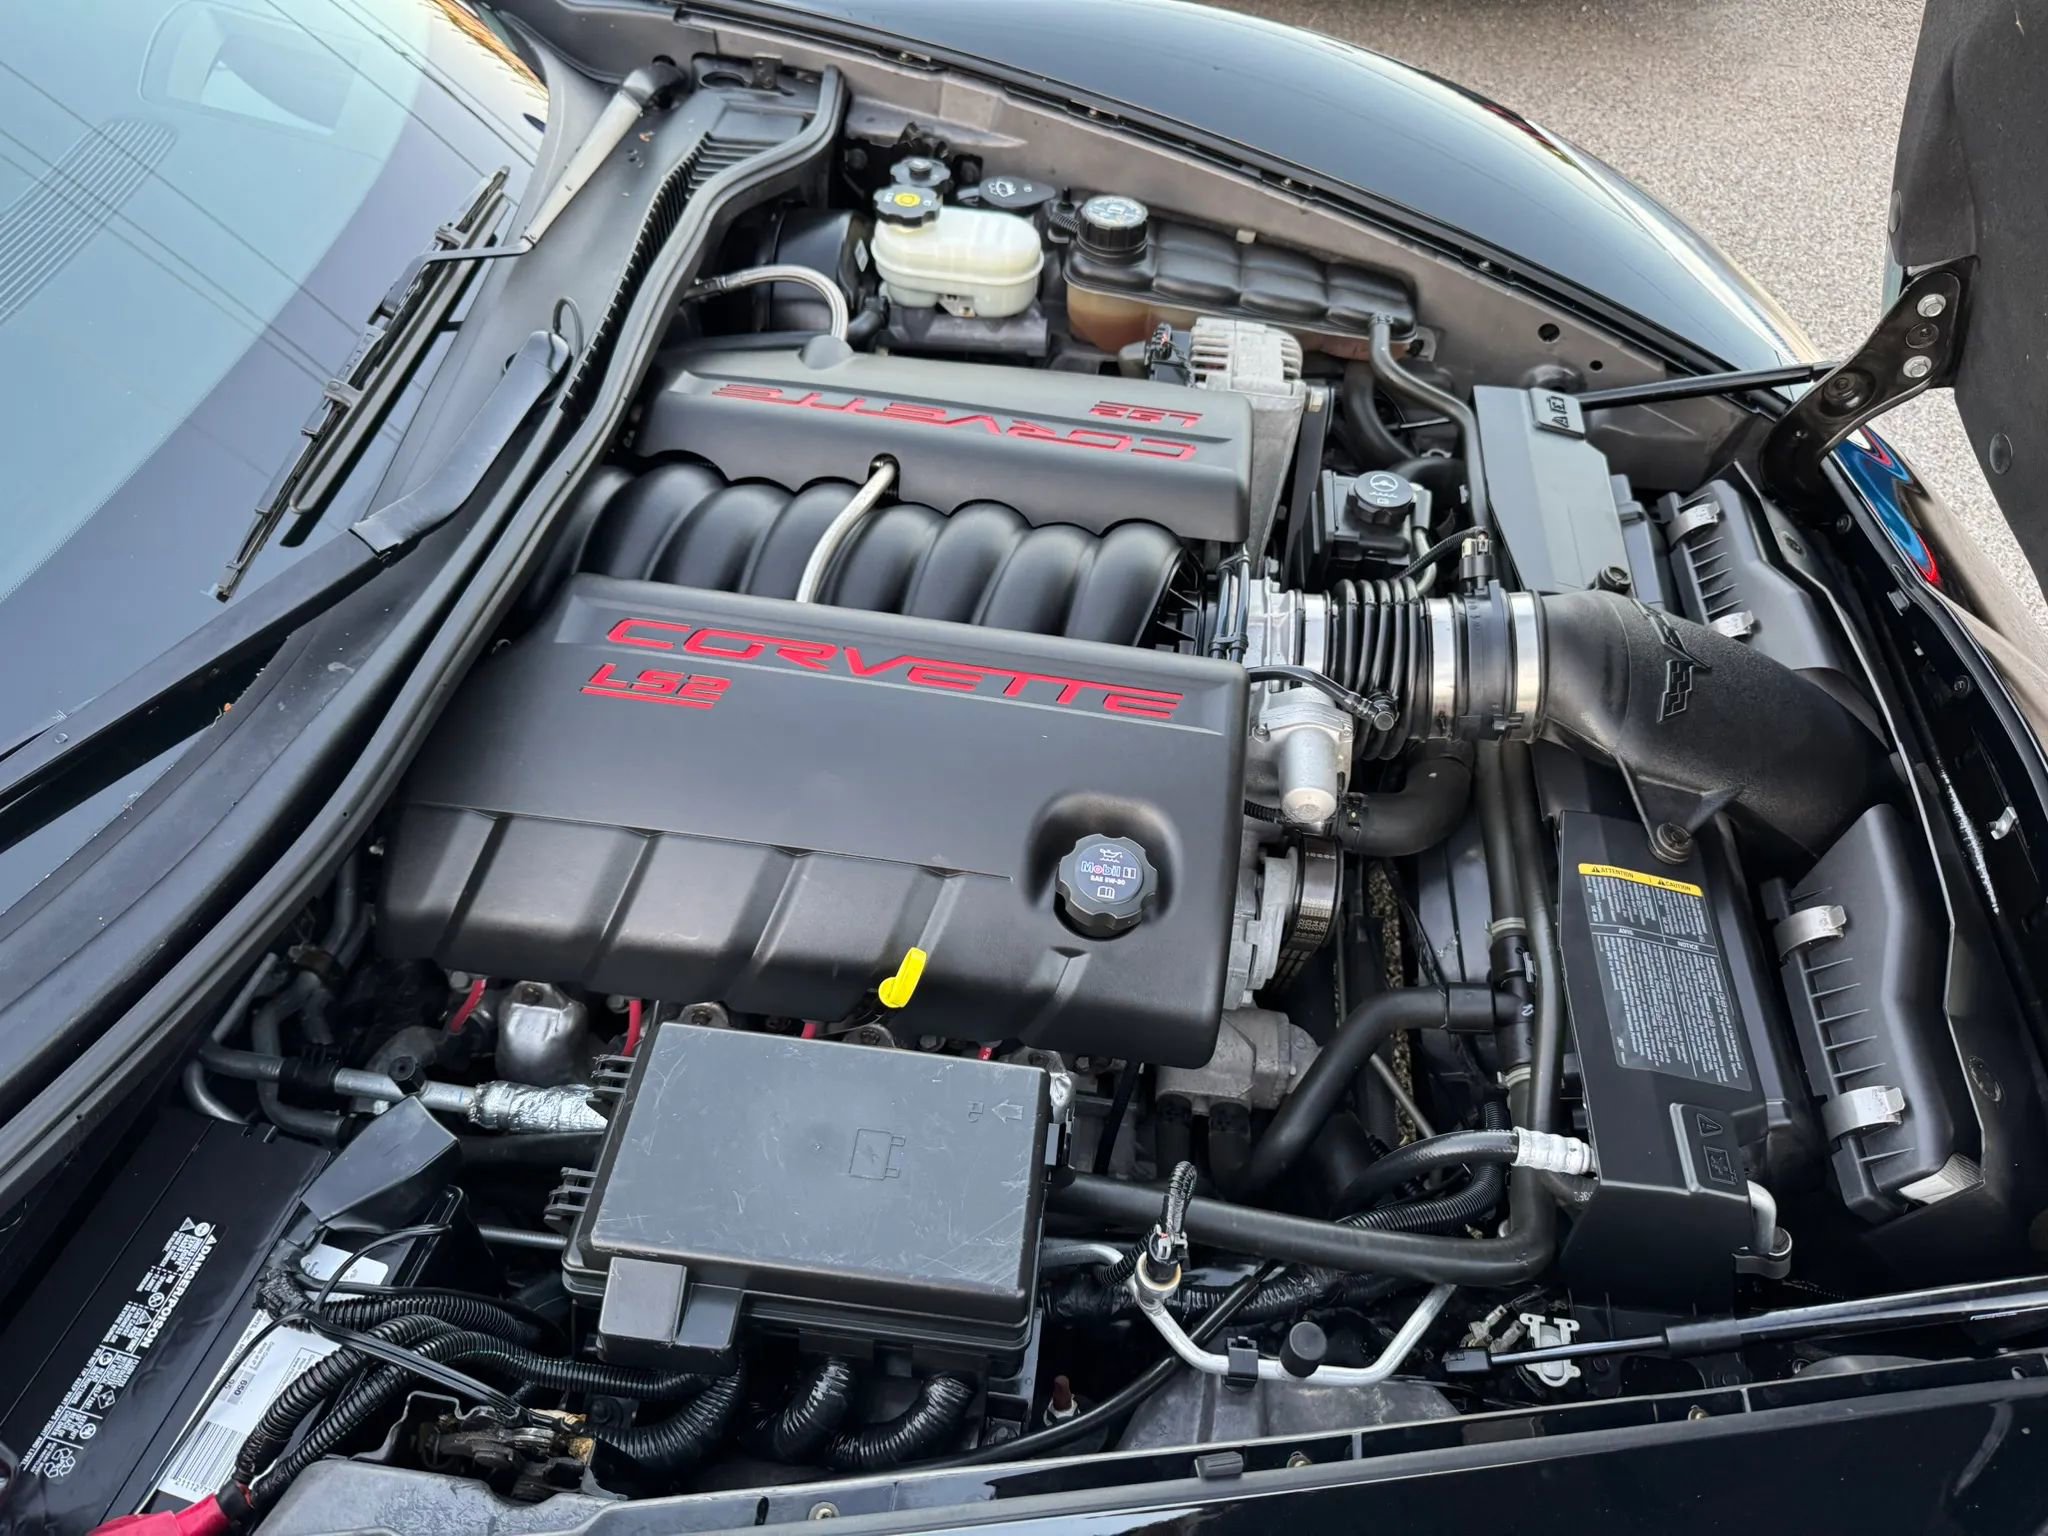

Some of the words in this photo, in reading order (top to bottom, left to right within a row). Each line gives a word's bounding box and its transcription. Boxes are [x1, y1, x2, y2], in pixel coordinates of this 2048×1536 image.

[712, 384, 1198, 462] CORVETTE
[1089, 401, 1203, 429] LS2
[606, 617, 1187, 722] CORVETTE
[582, 663, 734, 706] LS2
[1081, 861, 1121, 877] Mobil
[1600, 867, 1634, 879] ATTENTION
[1664, 880, 1692, 892] CAUTION
[1677, 941, 1700, 951] NOTICE
[139, 1245, 212, 1348] DANGER/POISON
[233, 1379, 248, 1397] 650
